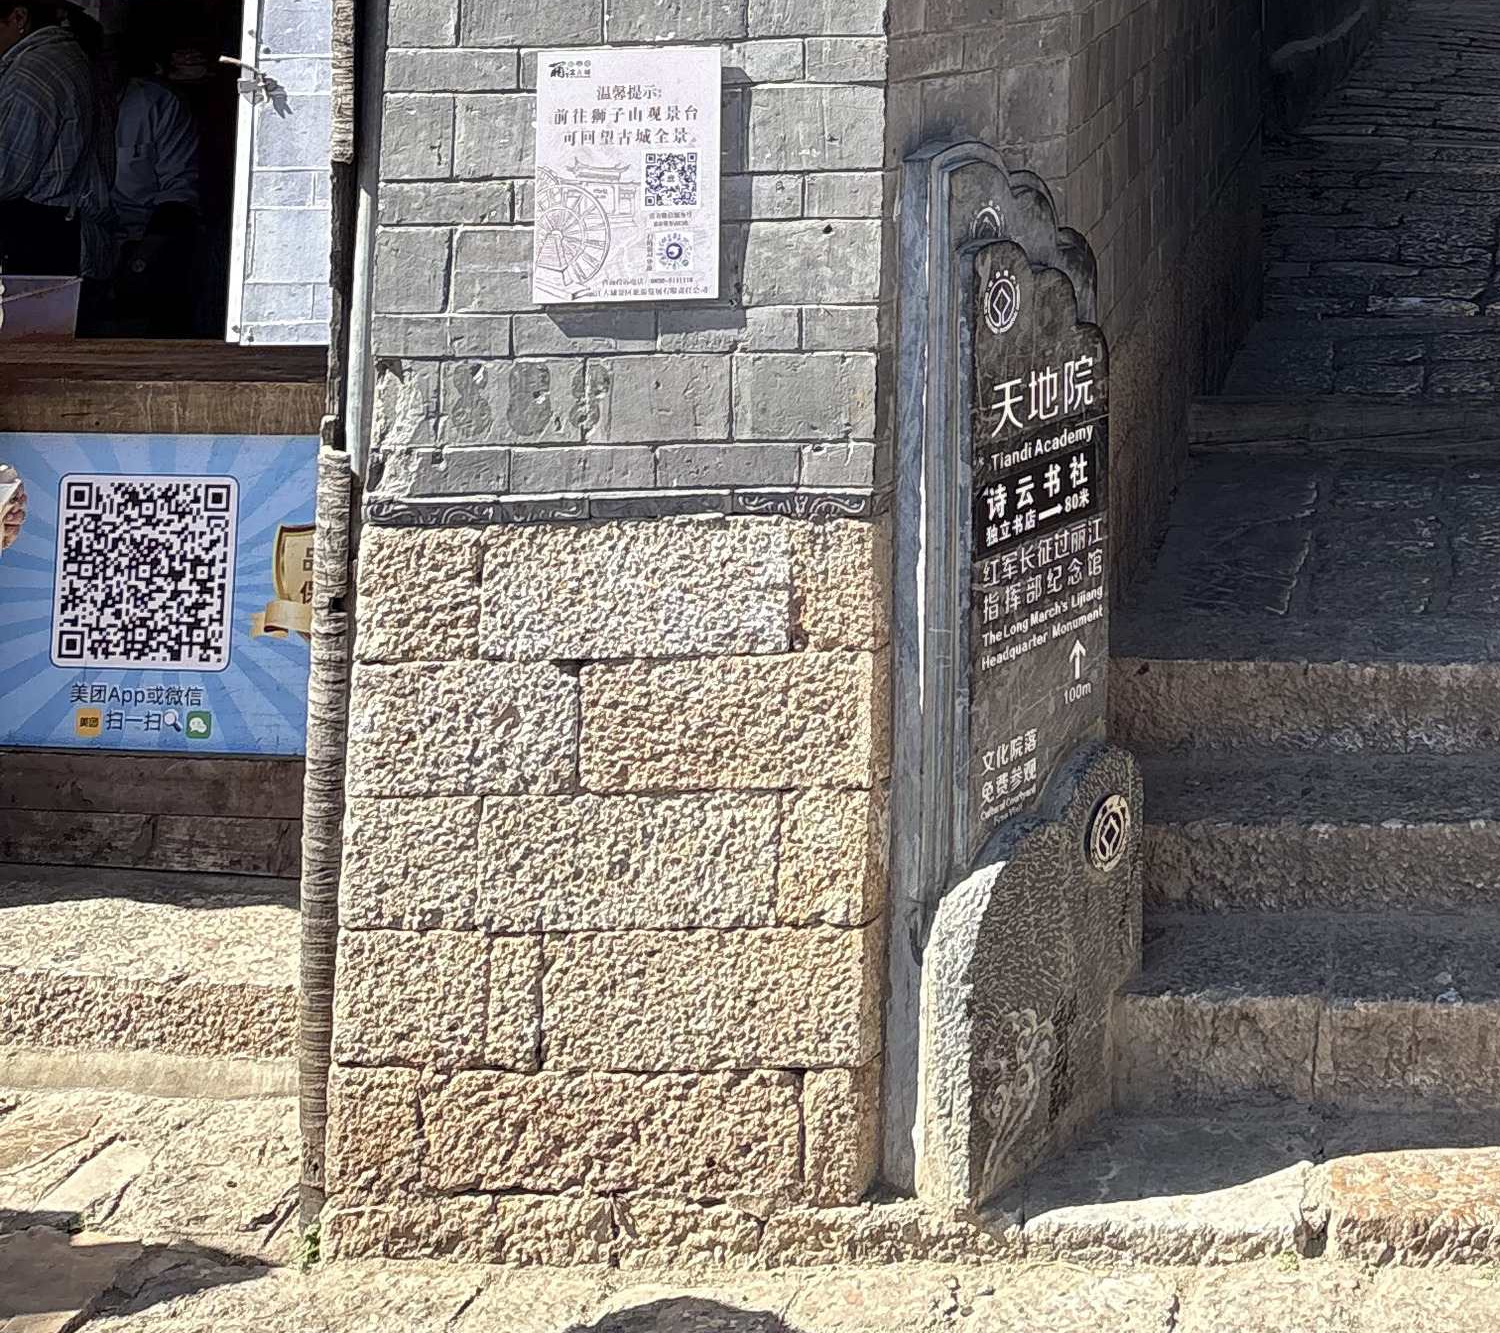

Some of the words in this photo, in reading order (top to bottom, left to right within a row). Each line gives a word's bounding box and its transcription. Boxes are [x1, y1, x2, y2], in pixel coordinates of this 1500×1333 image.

[991, 354, 1095, 439] 天地院
[991, 442, 1033, 472] Tiandi
[1034, 424, 1094, 456] Academy
[986, 452, 1089, 521] 诗云书社
[985, 508, 1037, 548] 独立书店
[1064, 487, 1090, 513] 80米
[983, 518, 1104, 589] 红军长征过丽江
[982, 631, 1002, 648] The
[1003, 618, 1029, 639] Long
[1030, 600, 1068, 625] March's
[1071, 585, 1103, 609] Lijiang
[983, 548, 1103, 624] 指挥部纪念馆
[981, 631, 1049, 671] Headquarter
[1052, 604, 1103, 639] Monument
[70, 683, 204, 707] 美团App或微信
[105, 708, 162, 732] 扫一扫
[1063, 682, 1092, 705] 100m
[980, 728, 1037, 777] 文化院落
[980, 757, 1037, 807] 免费参观
